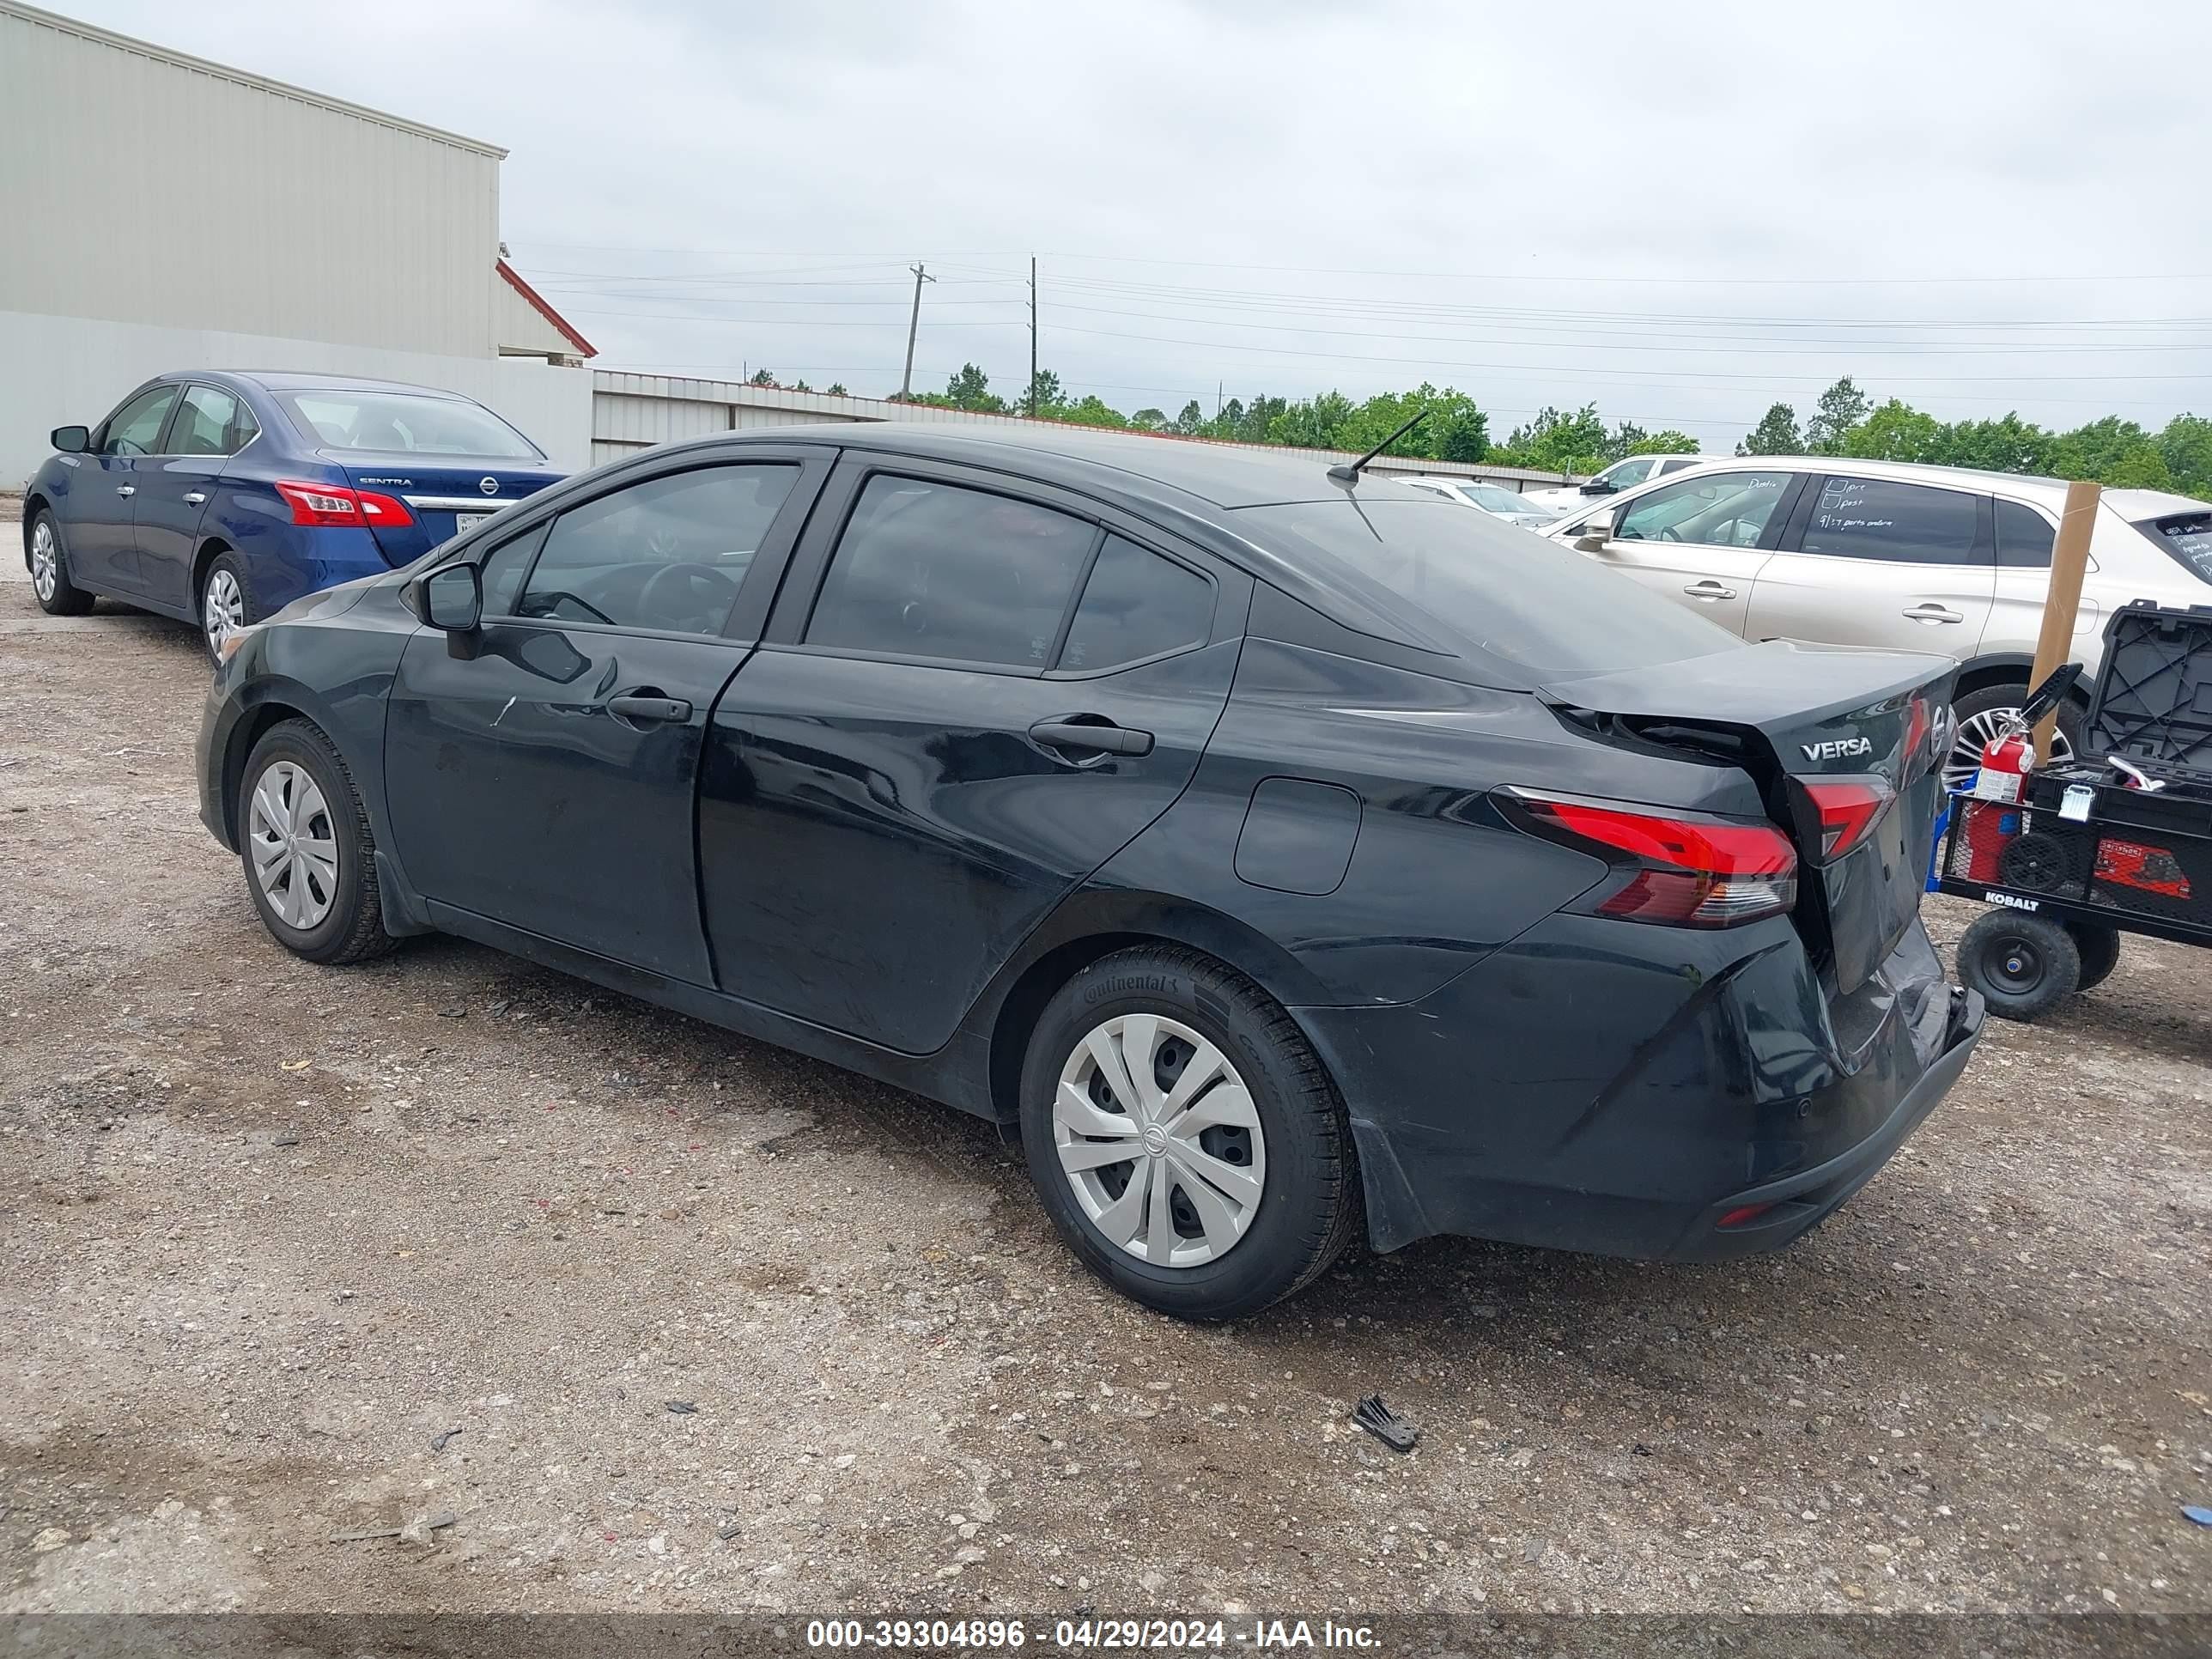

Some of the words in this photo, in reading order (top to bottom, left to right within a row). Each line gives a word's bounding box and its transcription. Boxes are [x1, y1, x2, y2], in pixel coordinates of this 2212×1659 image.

[359, 477, 413, 487] SENTRA
[1845, 484, 1866, 494] pre
[1839, 499, 1864, 511] post
[1800, 737, 1872, 761] VERSA
[1984, 891, 2039, 912] KOBALT
[1084, 975, 1167, 1004] Continental
